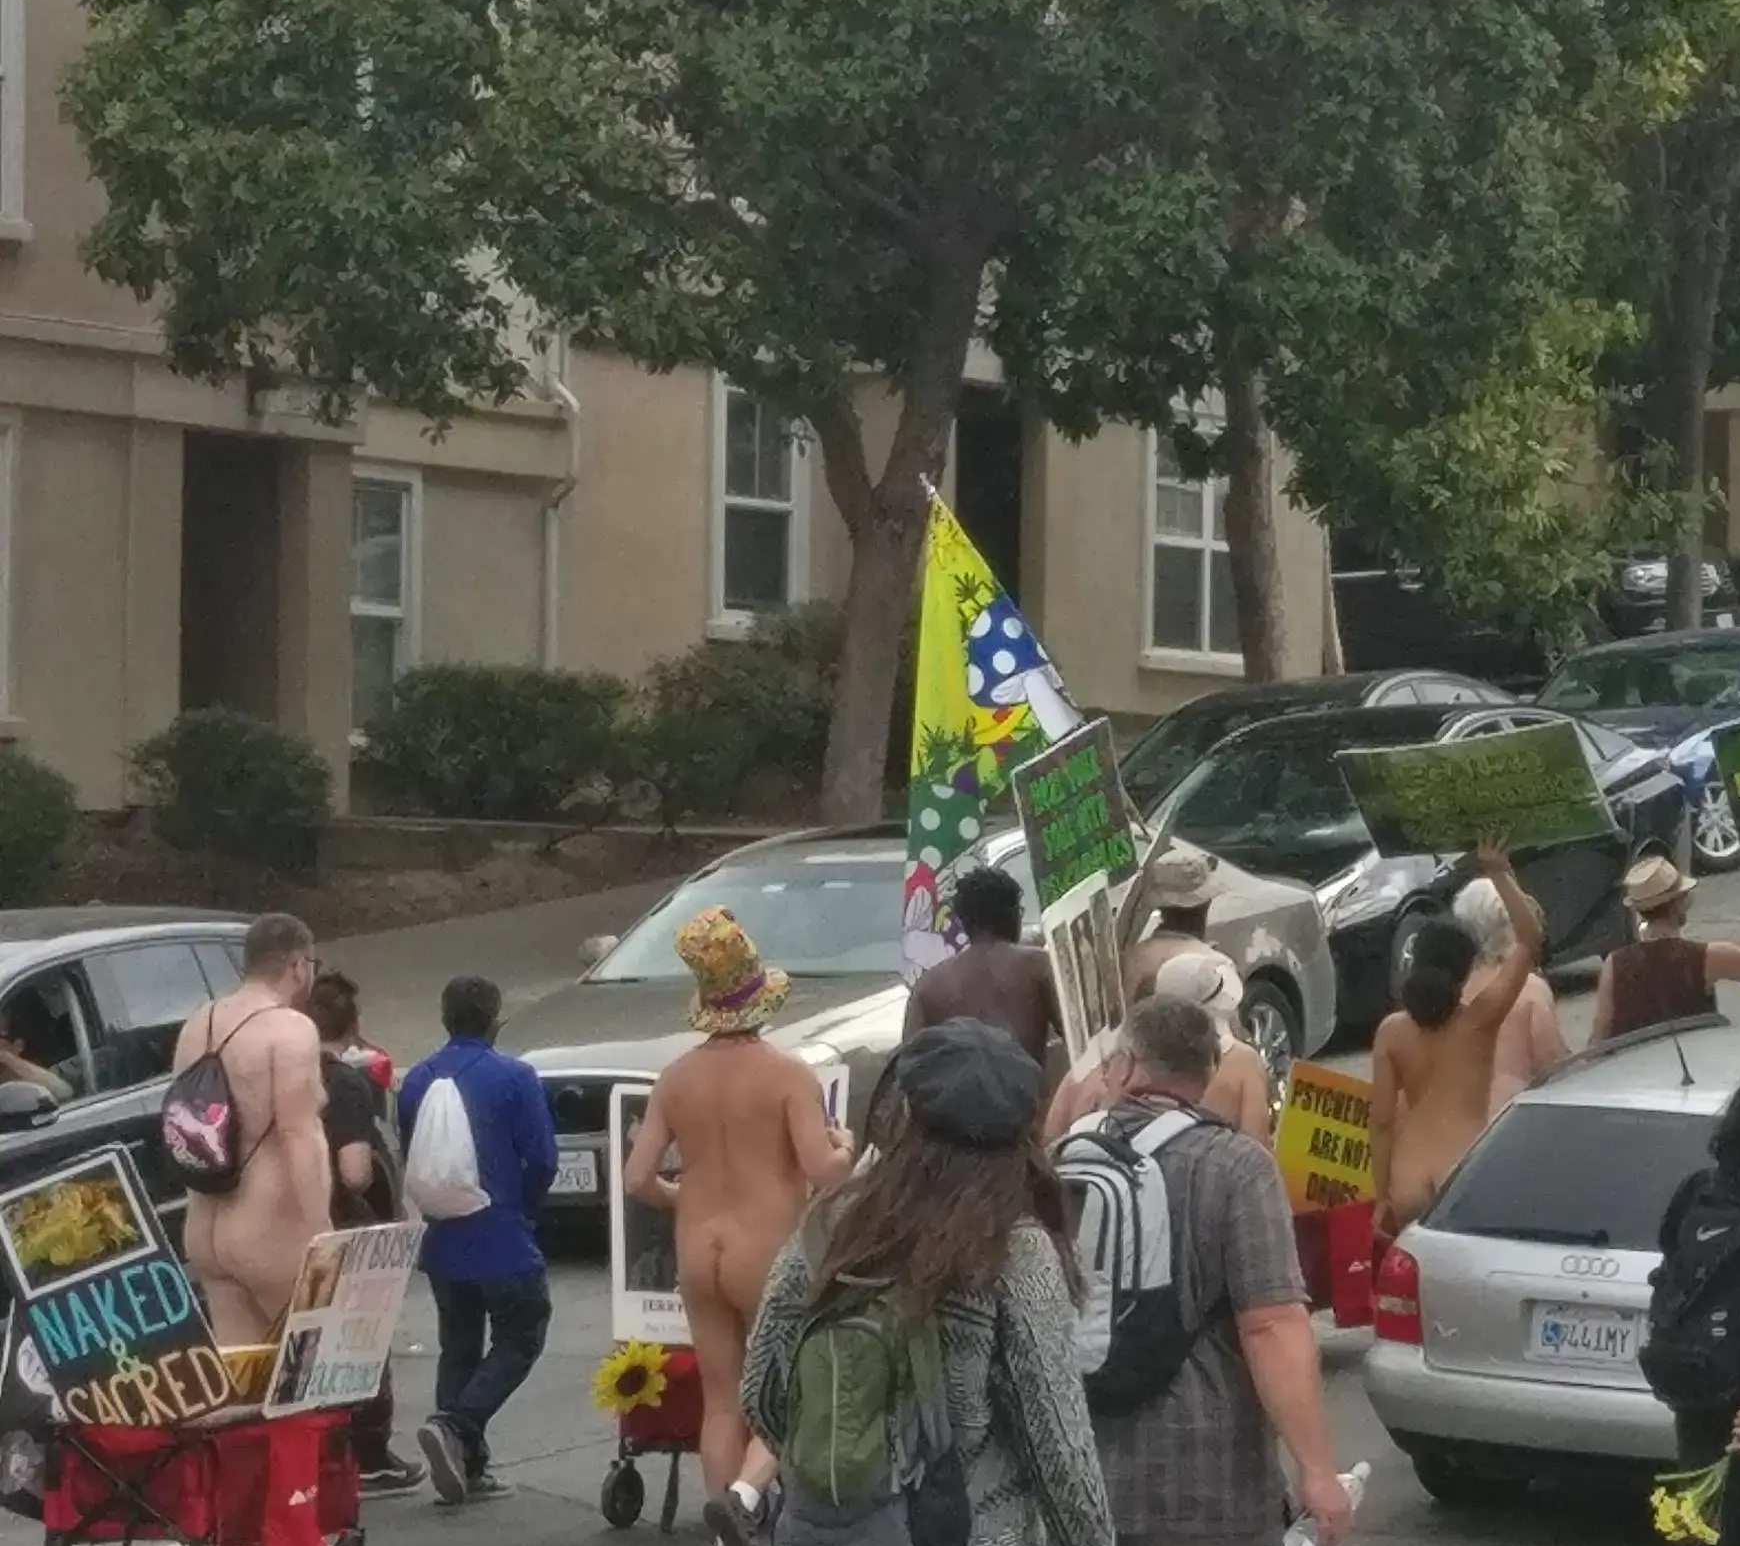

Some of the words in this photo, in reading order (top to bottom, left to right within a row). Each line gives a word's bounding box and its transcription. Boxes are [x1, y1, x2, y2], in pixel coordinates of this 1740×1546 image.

[29, 1260, 190, 1365] NAKED
[65, 1346, 231, 1426] SACRED
[110, 1335, 144, 1375] &
